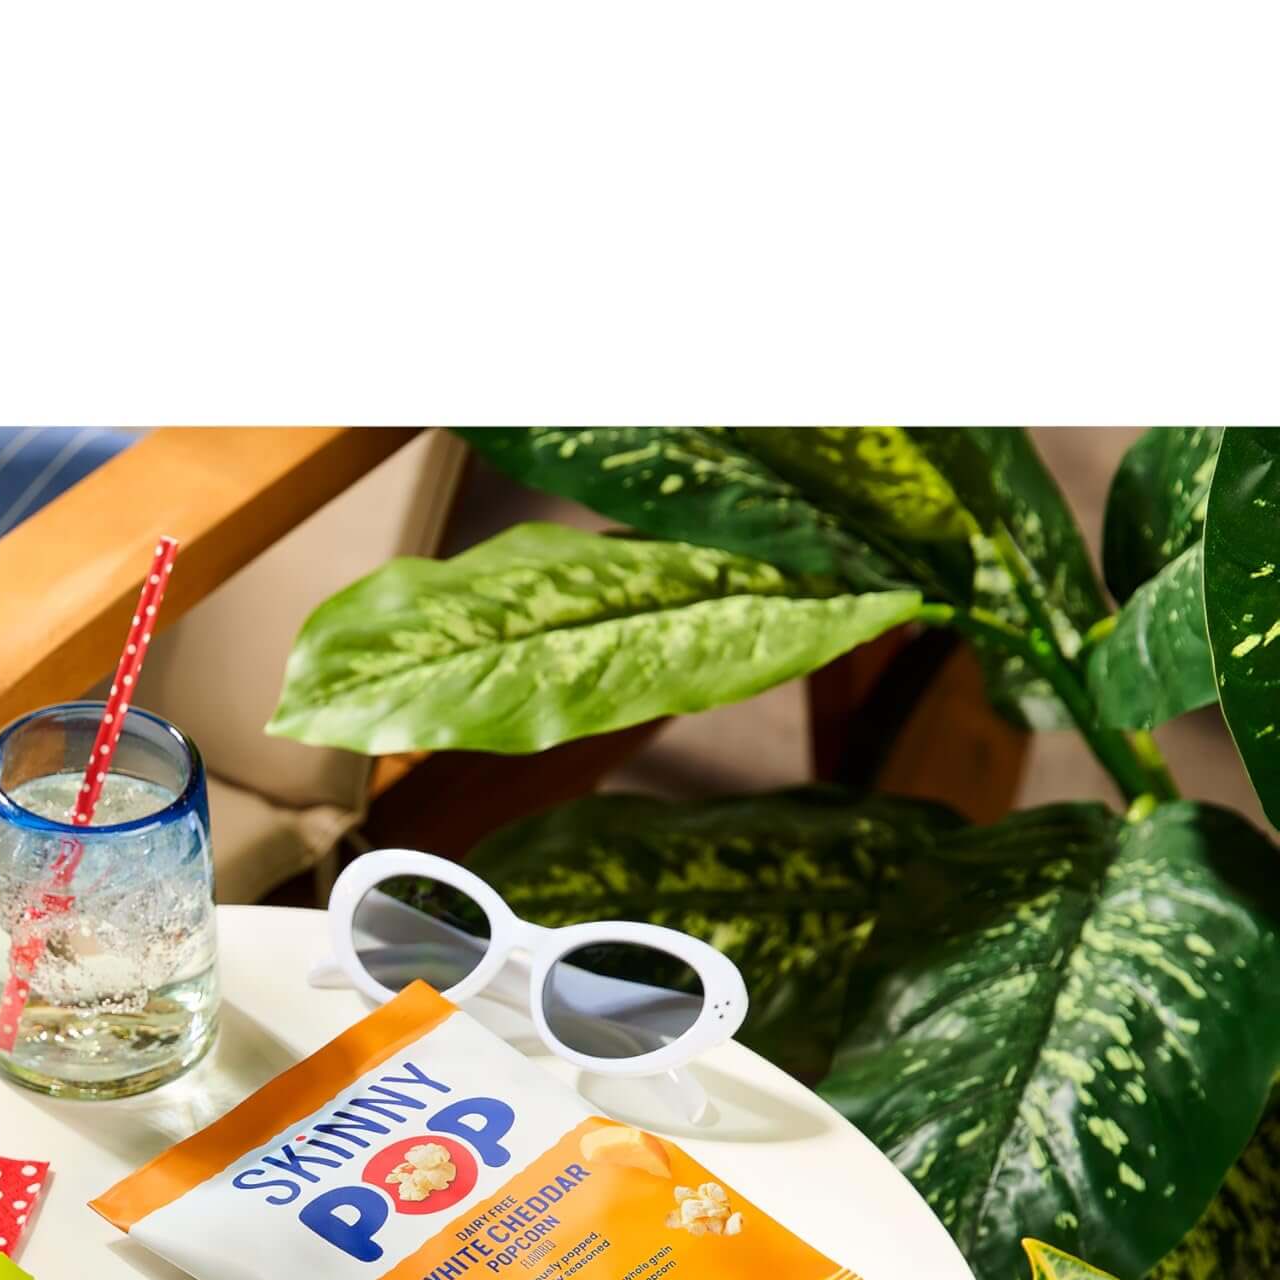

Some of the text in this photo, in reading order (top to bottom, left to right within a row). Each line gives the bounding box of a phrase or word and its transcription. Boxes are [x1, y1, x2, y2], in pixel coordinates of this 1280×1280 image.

[298, 1097, 516, 1263] POP
[456, 1195, 518, 1242] DAIRY FREE
[486, 1164, 591, 1243] CHEDDAR
[486, 1214, 561, 1273] POPCORN
[519, 1239, 557, 1270] FLAVORED
[561, 1231, 602, 1264] popped,
[564, 1239, 611, 1277] seasoned
[649, 1244, 673, 1266] grain
